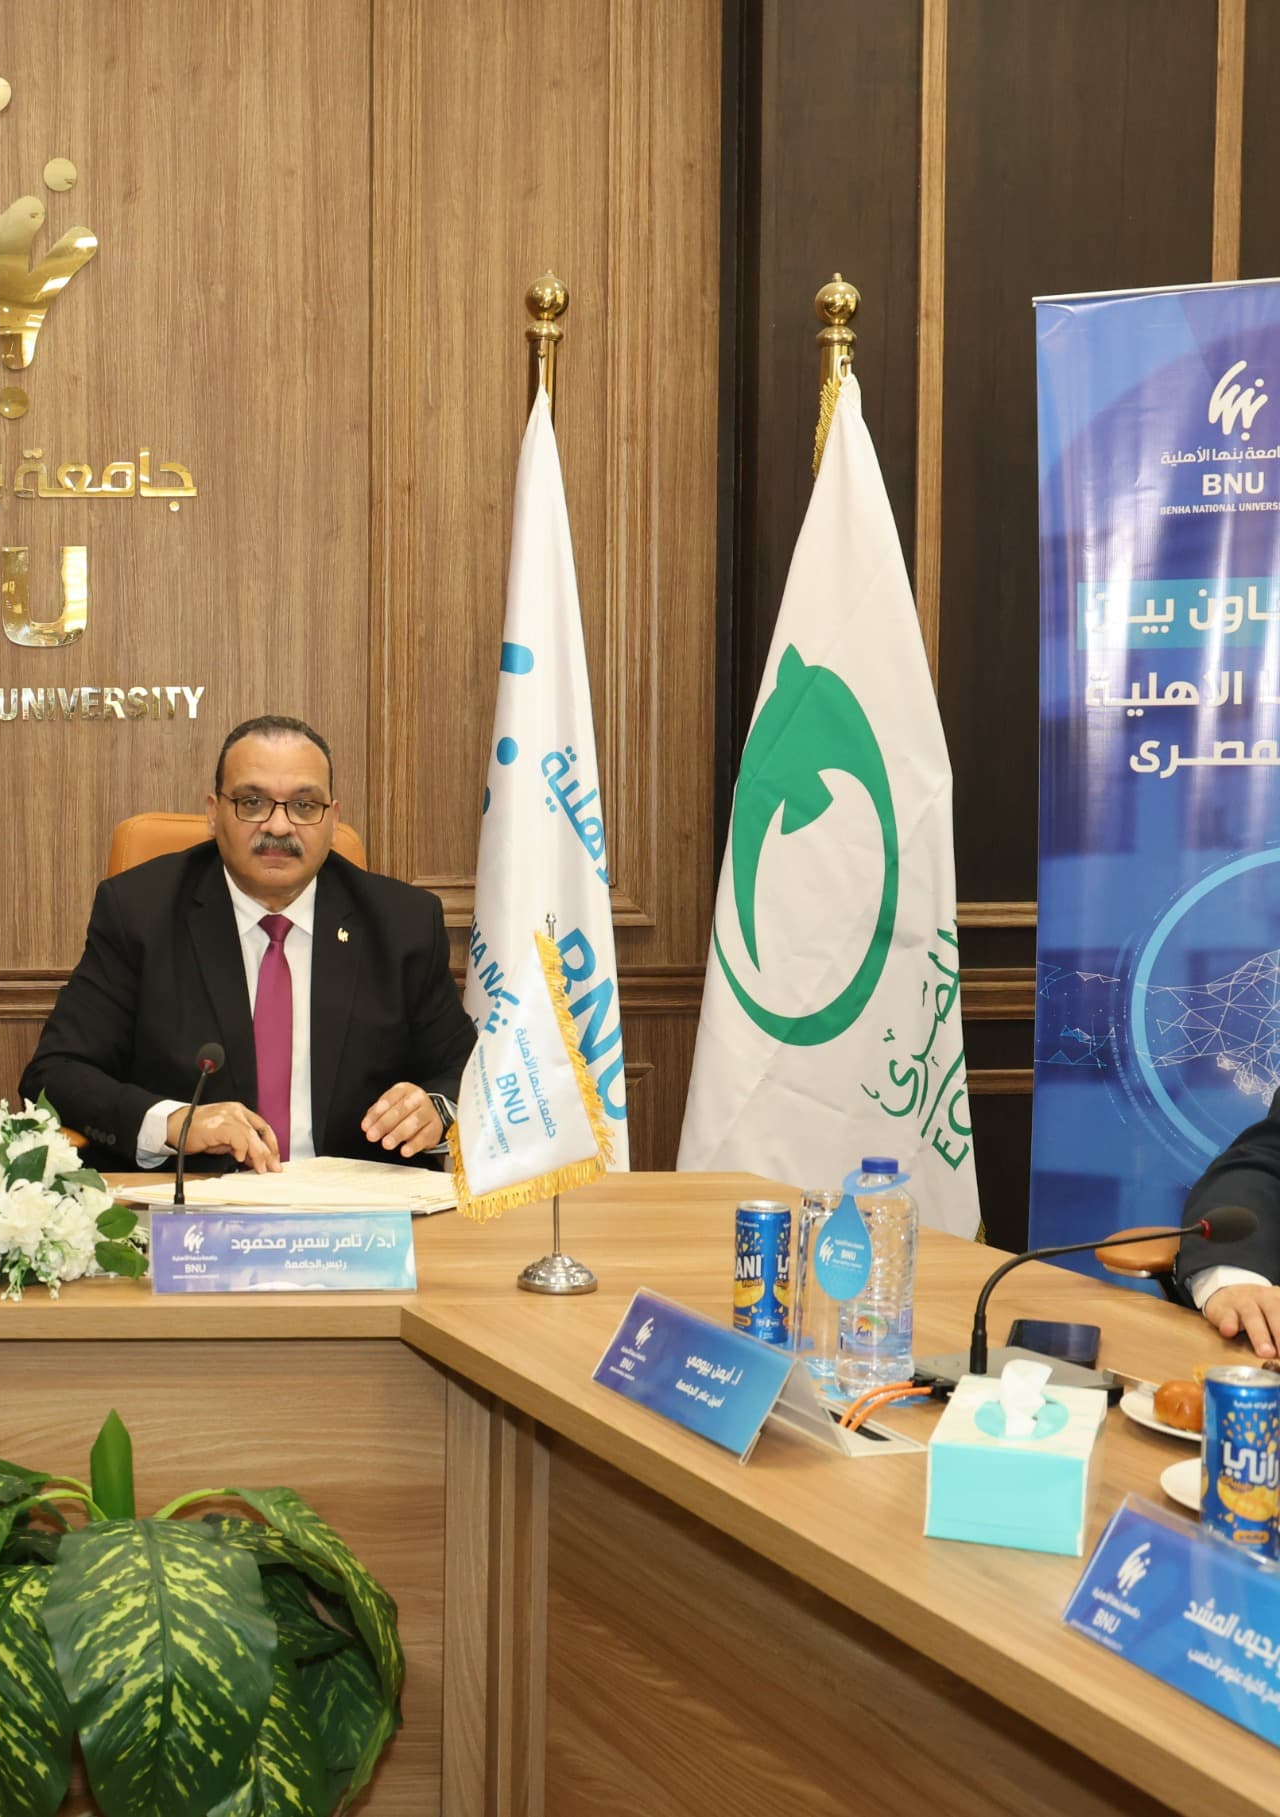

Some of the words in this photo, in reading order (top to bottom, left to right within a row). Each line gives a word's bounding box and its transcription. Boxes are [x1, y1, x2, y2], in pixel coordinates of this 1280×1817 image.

[1160, 446, 1210, 467] الأهلية
[1212, 447, 1243, 464] بنها
[1245, 445, 1280, 460] امعة
[14, 447, 198, 512] جامعة
[1202, 471, 1265, 496] BNU
[1160, 505, 1191, 516] BENHA
[1191, 503, 1236, 514] NATIONAL
[1238, 501, 1280, 512] UNIVERS
[1188, 585, 1280, 634] اون
[1129, 738, 1280, 780] مصرى
[555, 927, 628, 1122] BNU
[528, 1069, 545, 1099] بنها
[495, 1072, 530, 1126] BNU
[537, 1098, 558, 1139] جامعة
[231, 1238, 287, 1254] محمود
[289, 1236, 330, 1254] سمير
[332, 1232, 363, 1253] تامر
[185, 1263, 207, 1273] BNU
[284, 1258, 322, 1270] الجامعة
[323, 1258, 348, 1271] رئيس
[735, 1254, 762, 1279] ANI
[1092, 1607, 1122, 1635] BNU
